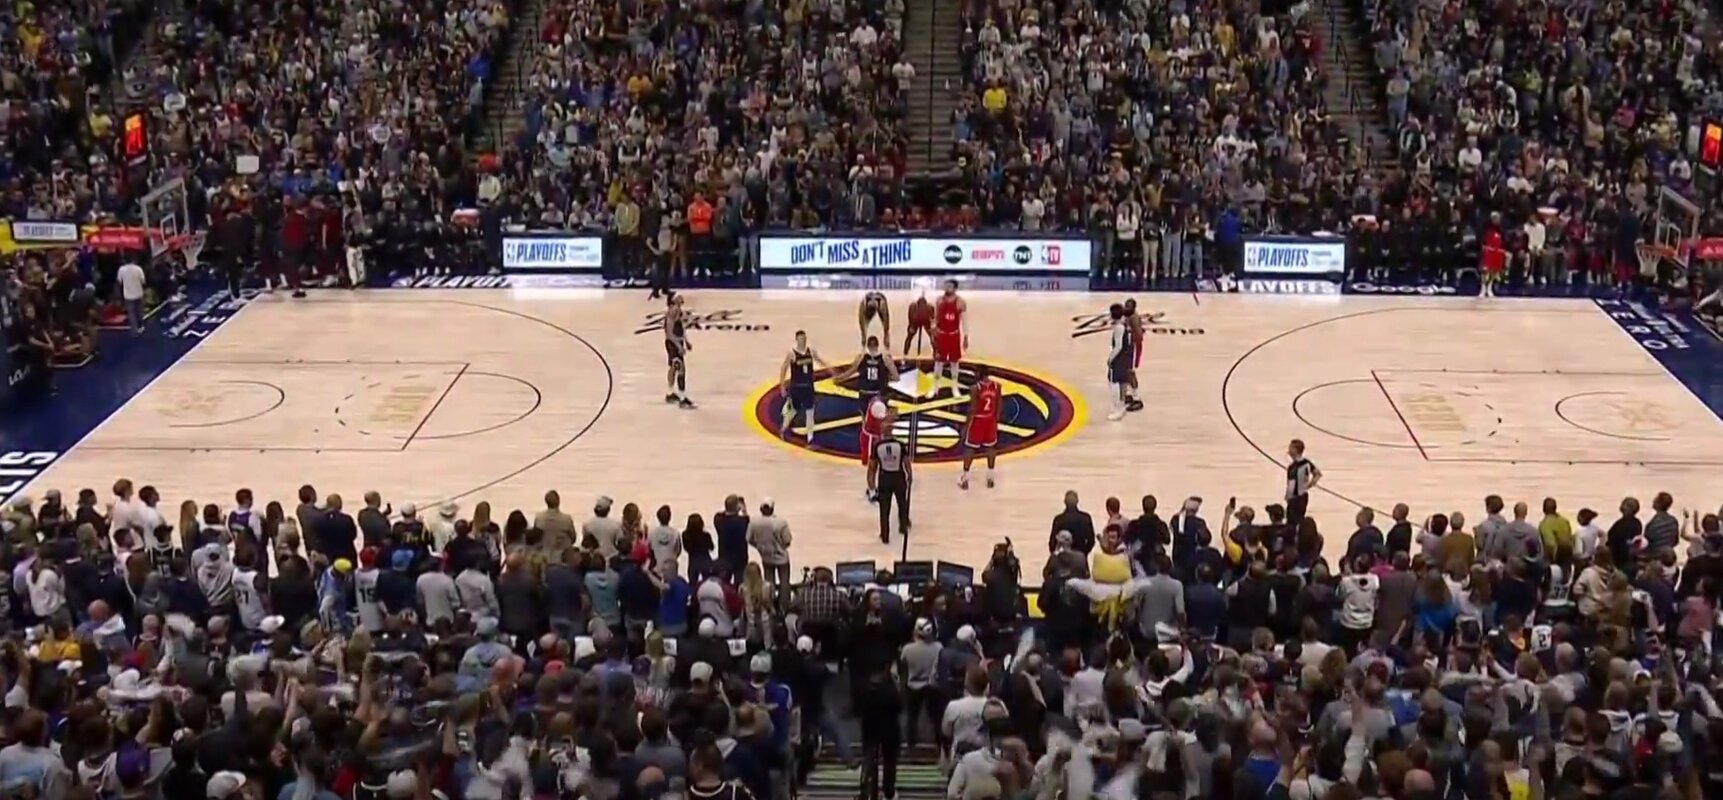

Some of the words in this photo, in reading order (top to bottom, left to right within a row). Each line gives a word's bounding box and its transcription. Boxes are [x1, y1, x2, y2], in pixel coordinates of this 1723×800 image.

[516, 243, 567, 262] PLAYOFFS
[791, 241, 825, 264] DON'T
[828, 240, 859, 265] MISS
[862, 248, 869, 265] A
[871, 239, 911, 267] THING
[971, 250, 1004, 260] ESPN
[1258, 247, 1309, 267] PLAYOFFS
[1221, 280, 1335, 293] PLAYOFFS
[1352, 281, 1456, 295] Google
[984, 397, 992, 411] 2
[0, 451, 58, 502] LIS
